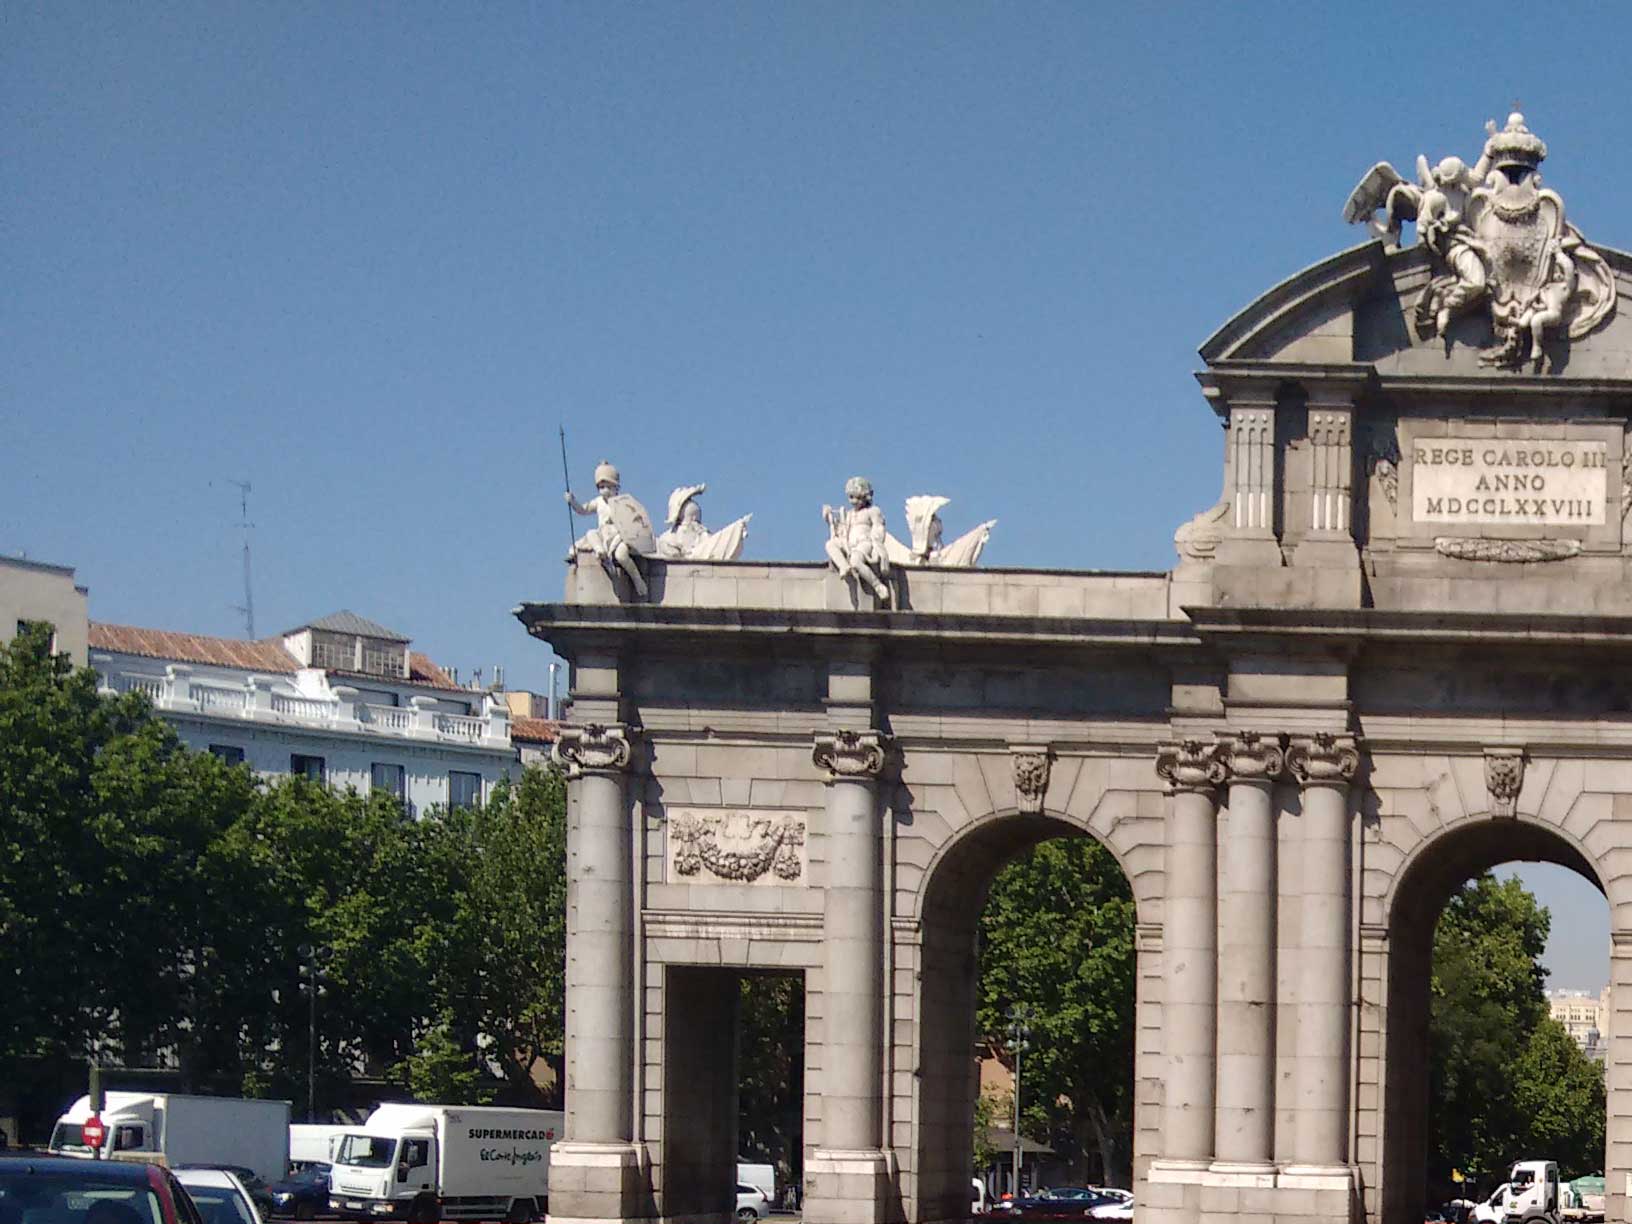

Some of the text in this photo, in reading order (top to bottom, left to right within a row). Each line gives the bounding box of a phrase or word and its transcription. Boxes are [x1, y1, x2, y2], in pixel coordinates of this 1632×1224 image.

[1414, 449, 1607, 468] REGE CAROLO III
[1475, 474, 1546, 491] ANNO
[1426, 498, 1593, 517] MDCCLXXVIII
